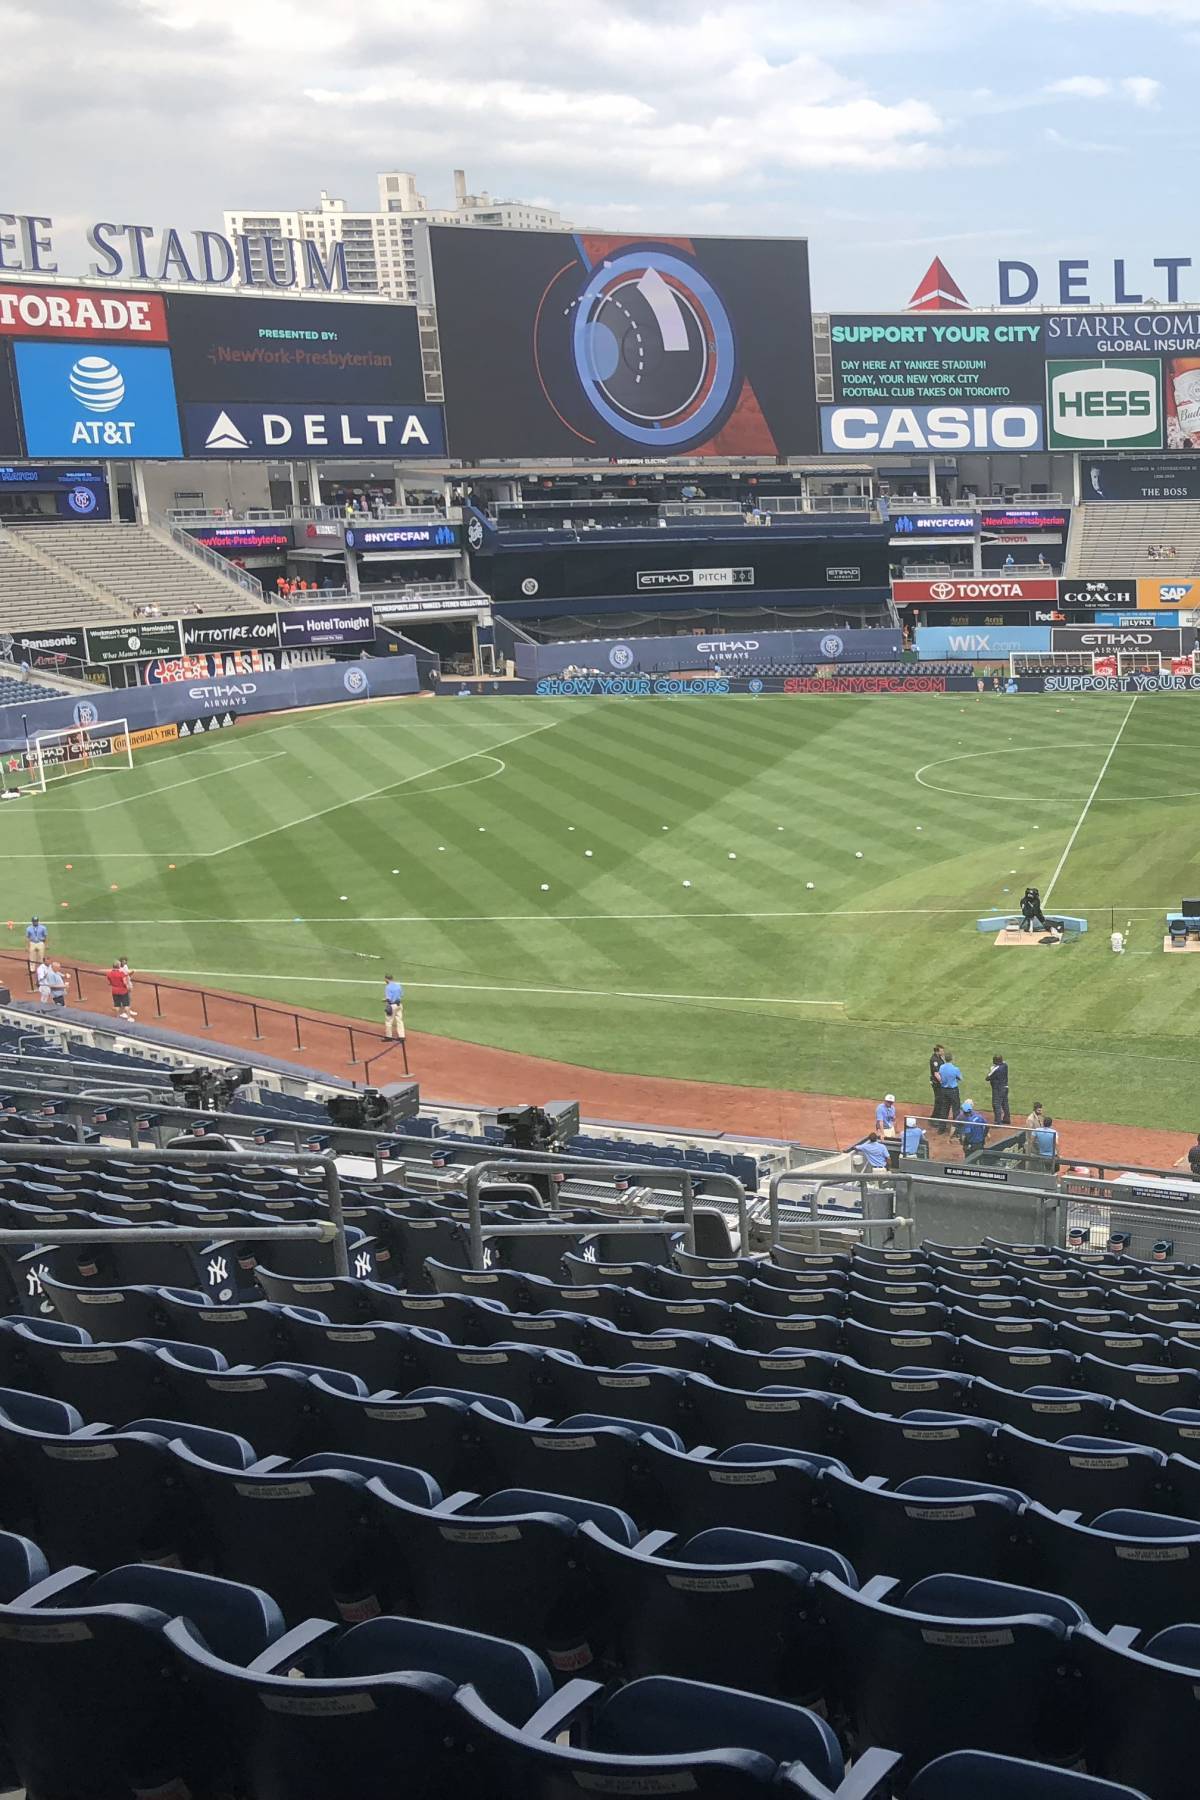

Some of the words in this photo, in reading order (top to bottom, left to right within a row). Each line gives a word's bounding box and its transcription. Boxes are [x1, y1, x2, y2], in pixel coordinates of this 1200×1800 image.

[88, 221, 352, 291] STADIUM
[1048, 316, 1127, 338] STARR
[258, 328, 318, 340] PRESENTED
[321, 330, 338, 341] BY:
[832, 326, 927, 343] SUPPORT
[930, 326, 989, 343] YOUR
[994, 325, 1040, 343] CITY
[1097, 338, 1150, 352] GLOBAL
[218, 347, 392, 369] NewYork-Presbyterian
[841, 361, 860, 370] DAY
[863, 360, 886, 370] HERE
[889, 360, 901, 370] AT
[903, 360, 939, 370] YANKEE
[942, 359, 986, 369] STADIUM!
[843, 375, 876, 385] TODAY,
[879, 374, 903, 384] YOUR
[906, 374, 926, 384] NEW
[929, 374, 954, 384] YORK
[957, 374, 979, 384] CITY
[843, 387, 887, 398] FOOTBALL
[890, 387, 914, 397] CLUB
[917, 387, 945, 397] TAKES
[948, 387, 962, 397] ON
[965, 386, 1010, 397] TORONTO
[1059, 390, 1150, 417] HESS
[71, 421, 135, 445] AT&T
[263, 413, 430, 446] DELTA
[830, 408, 1037, 449] CASIO
[1141, 488, 1160, 496] THE
[1163, 488, 1188, 496] BOSS
[917, 518, 974, 528] #NYCFCFAM
[985, 516, 1064, 527] NewYork-Presbyterian
[364, 530, 429, 543] #NYCFCFAM
[1000, 535, 1027, 543] TOYOTA
[641, 573, 690, 585] ETIHAD
[698, 571, 727, 582] PITCH
[957, 584, 1022, 597] TOYOTA
[1160, 587, 1186, 600] SAP
[1065, 593, 1130, 602] COACH
[1035, 611, 1065, 621] FedEx
[184, 621, 278, 644] NITTOTIRE.COM
[21, 635, 77, 649] Panasonic
[697, 640, 759, 652] ETIHAD
[1081, 634, 1152, 645] ETIHAD
[709, 652, 749, 661] AIRWAYS
[536, 679, 596, 695] SHOW
[600, 679, 650, 694] YOUR
[654, 679, 729, 693] COLORS
[784, 677, 945, 693] SHOP.NYCFC.COM
[1045, 676, 1130, 692] SUPPORT
[1131, 675, 1184, 691] YOUR
[189, 682, 257, 699] ETIHAD
[204, 696, 247, 708] AIRWAYS
[161, 728, 176, 738] TIRE
